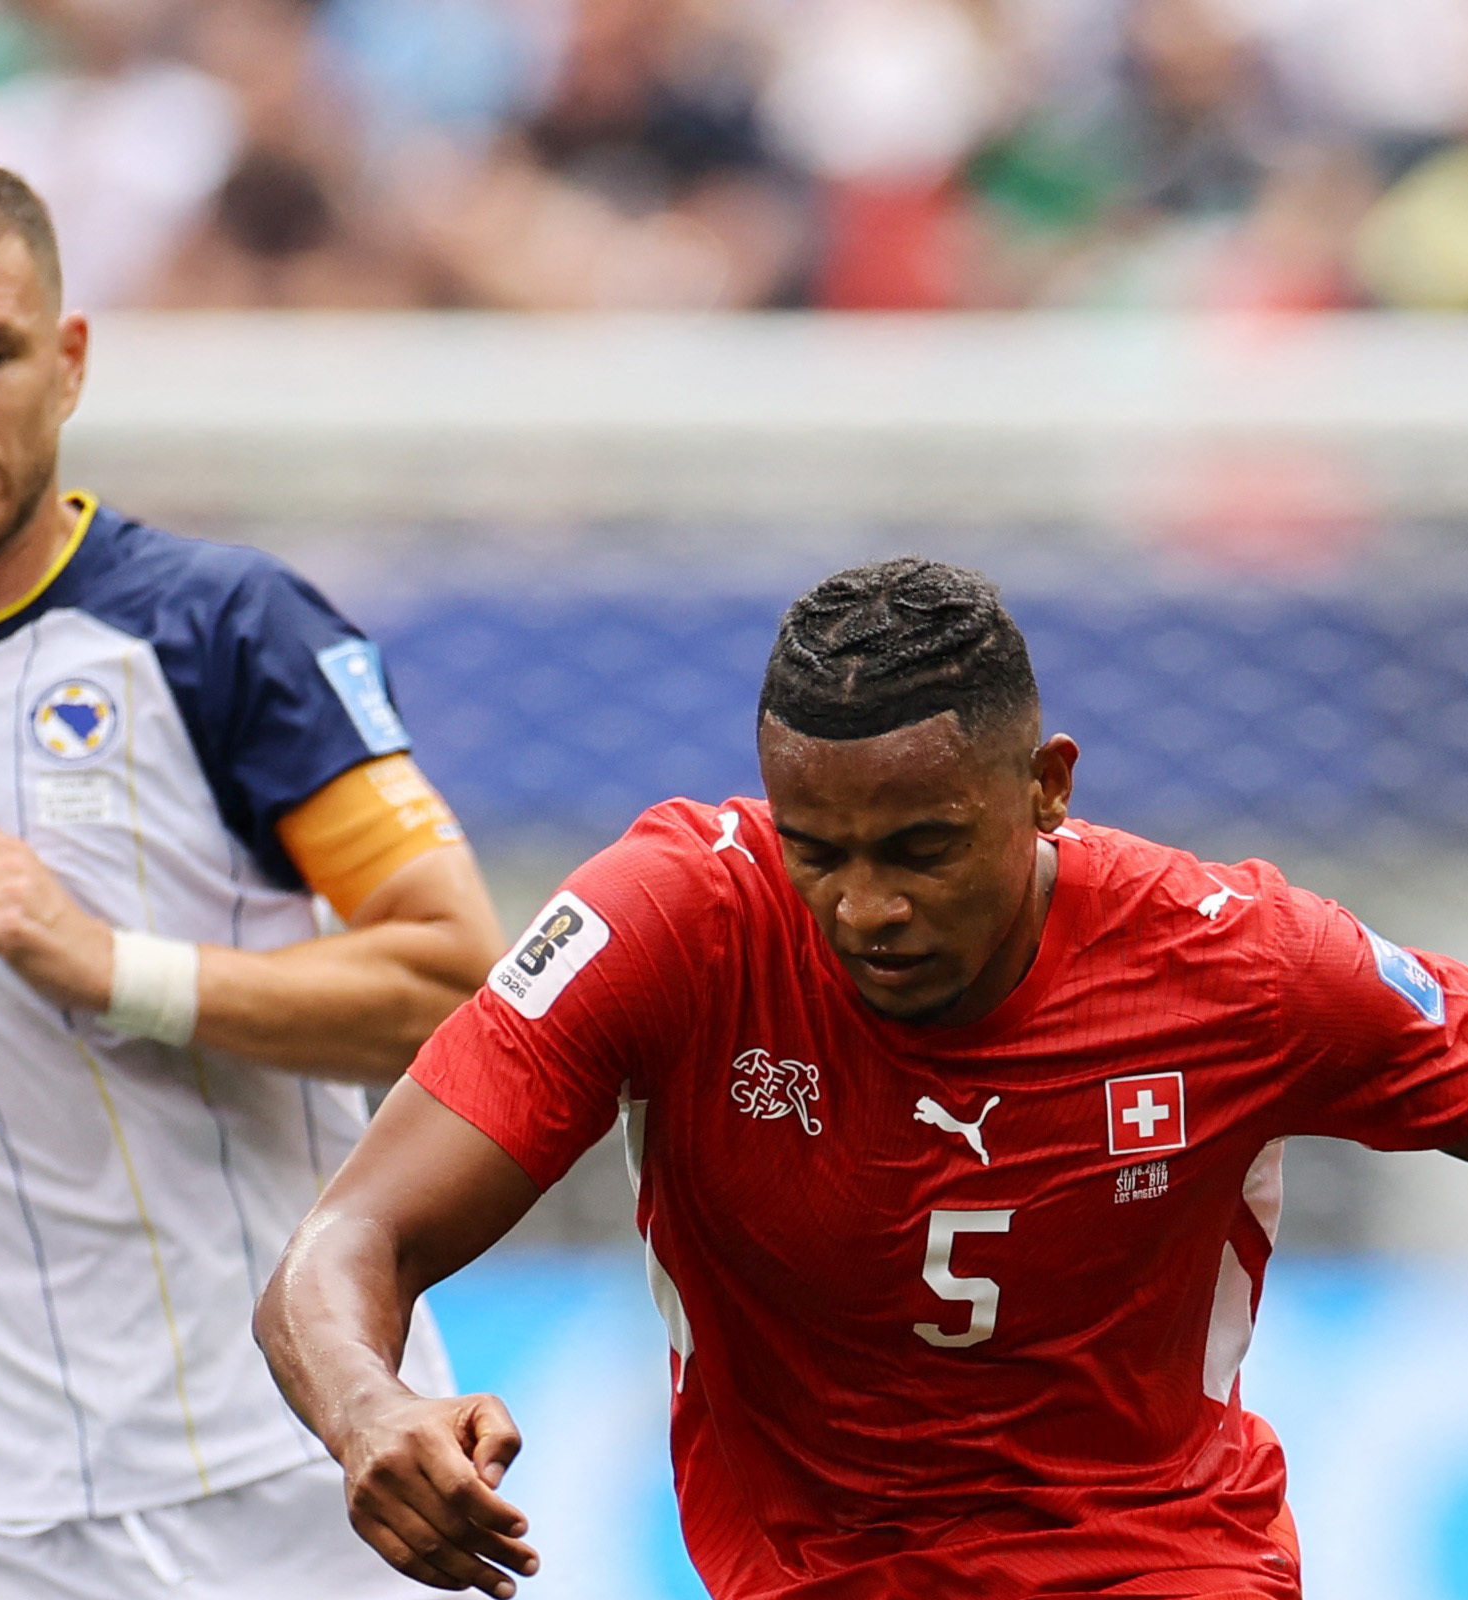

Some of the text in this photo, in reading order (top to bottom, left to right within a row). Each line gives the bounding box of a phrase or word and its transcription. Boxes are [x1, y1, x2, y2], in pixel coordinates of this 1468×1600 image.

[497, 972, 527, 999] 2026
[1116, 1176, 1136, 1192] SUI
[1149, 1171, 1168, 1187] BIH
[1114, 1192, 1131, 1204] LOS
[912, 1208, 1018, 1348] 5
